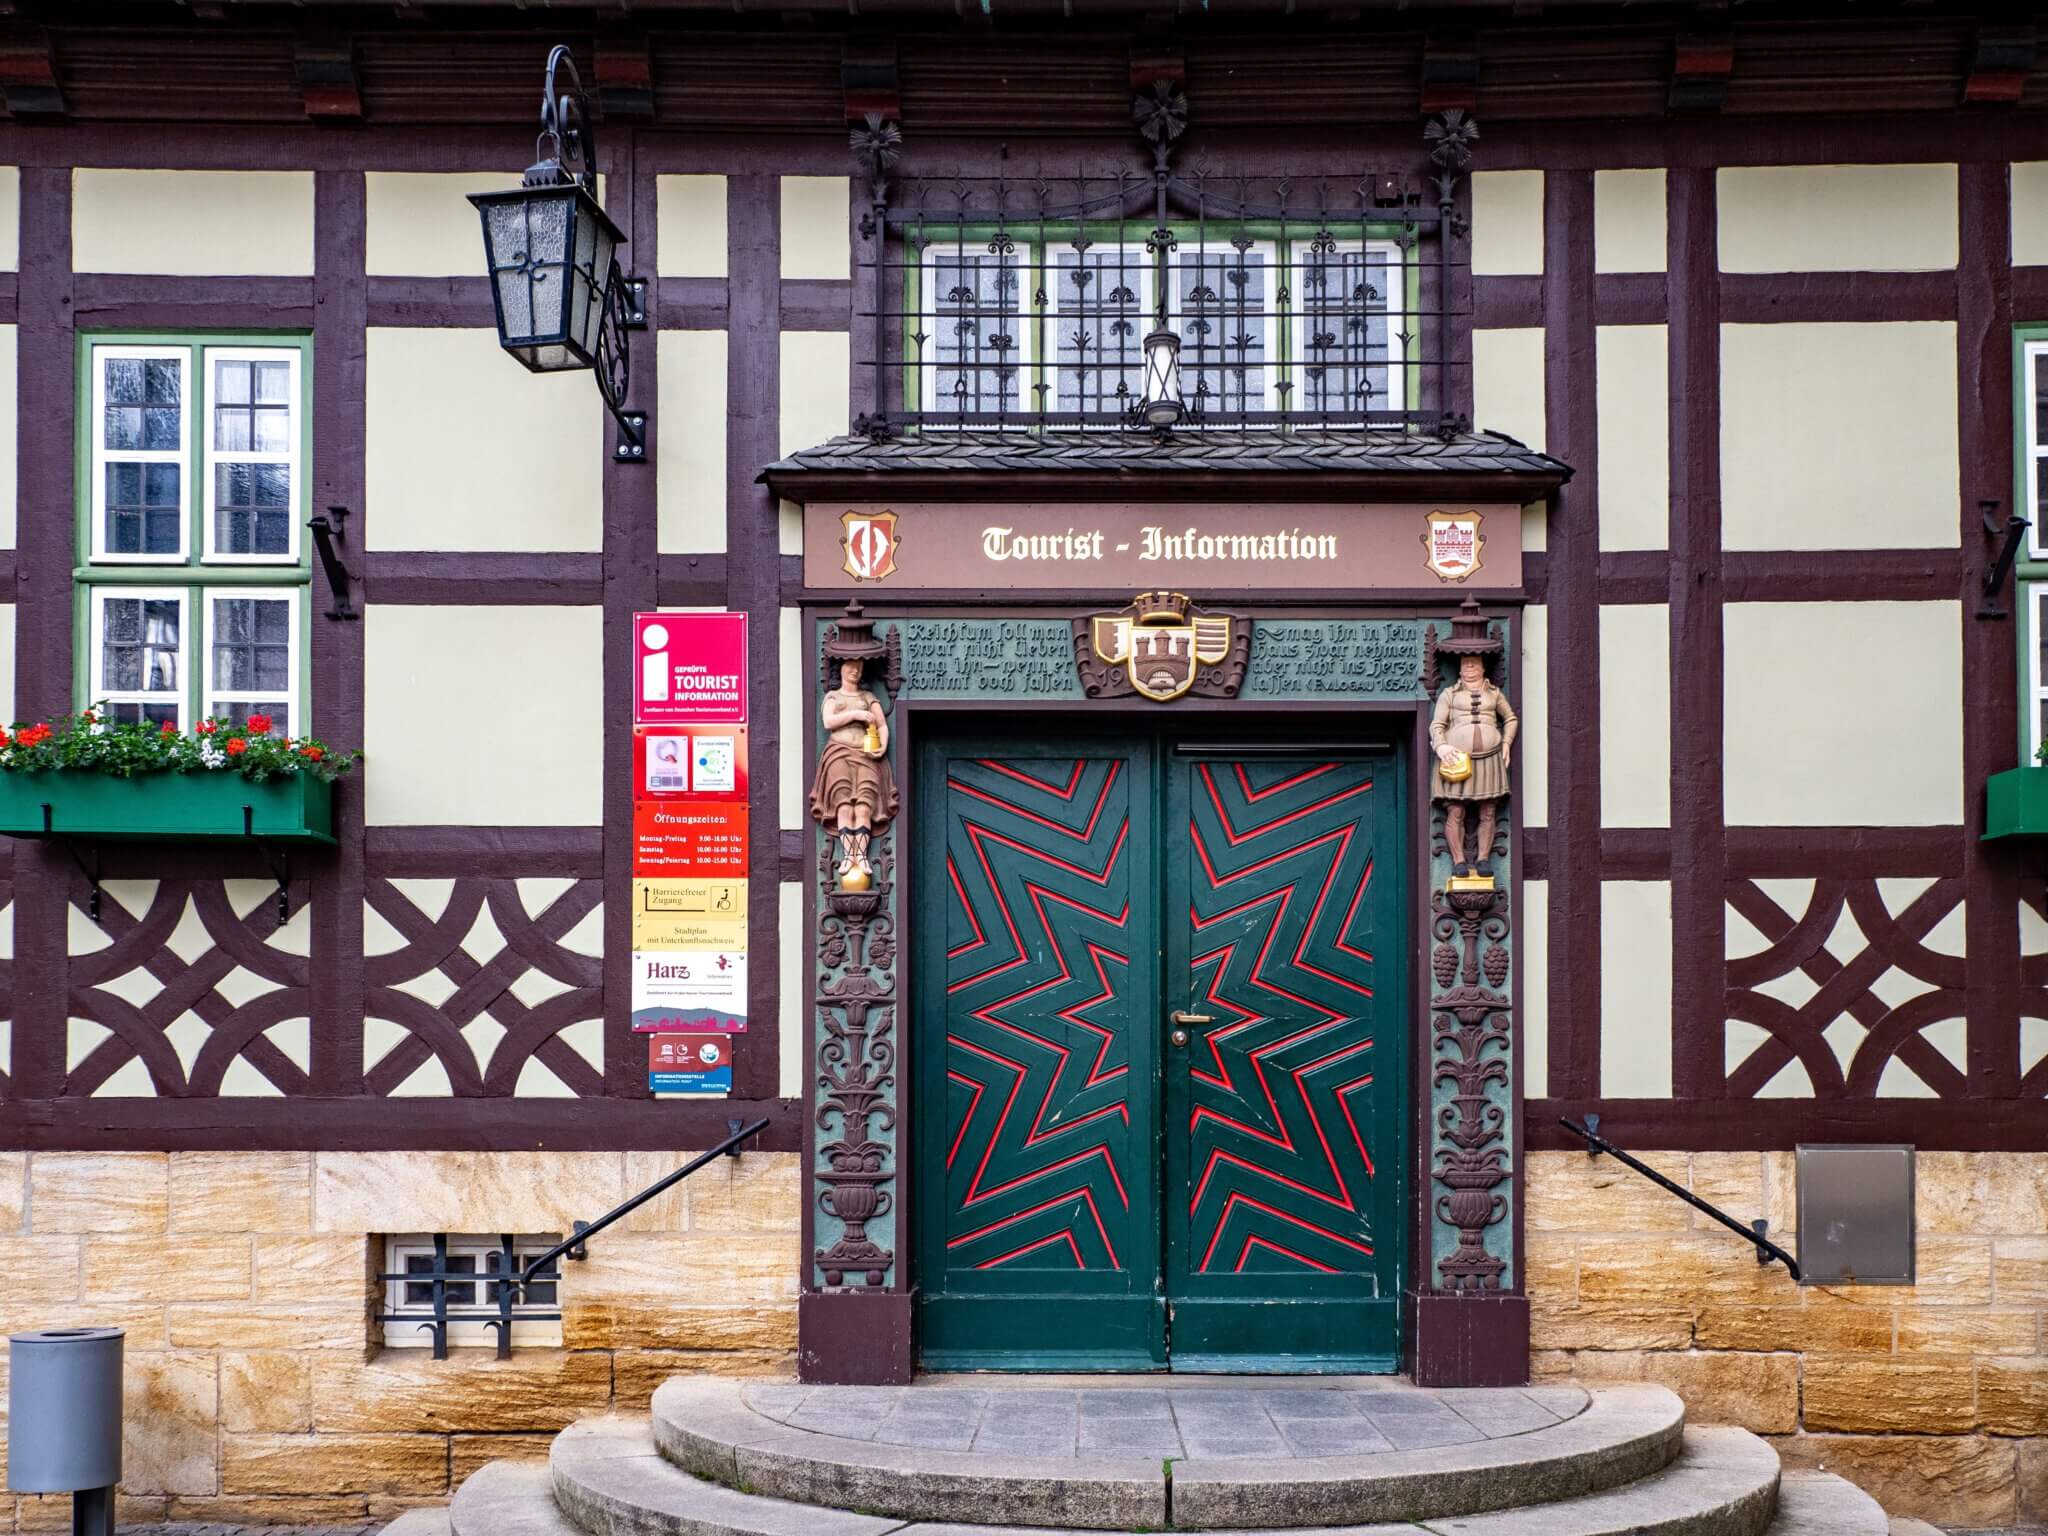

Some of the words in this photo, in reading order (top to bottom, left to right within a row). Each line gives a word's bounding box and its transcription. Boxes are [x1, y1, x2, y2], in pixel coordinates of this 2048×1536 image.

[981, 526, 1104, 561] Tourist
[1138, 526, 1338, 561] Information
[1031, 627, 1068, 641] man
[1286, 627, 1323, 644] mag
[1361, 625, 1379, 641] in
[1015, 641, 1068, 658] lieben
[909, 660, 947, 677] mag
[1055, 661, 1073, 674] er
[674, 675, 738, 689] TOURIST
[1097, 667, 1124, 687] 19
[1197, 667, 1225, 688] 40
[674, 692, 738, 701] INFORMATION
[654, 813, 728, 824] Öffnungszeiten:
[652, 888, 706, 896] Barrierefreier
[652, 896, 683, 906] Zugang
[647, 962, 690, 979] Harz
